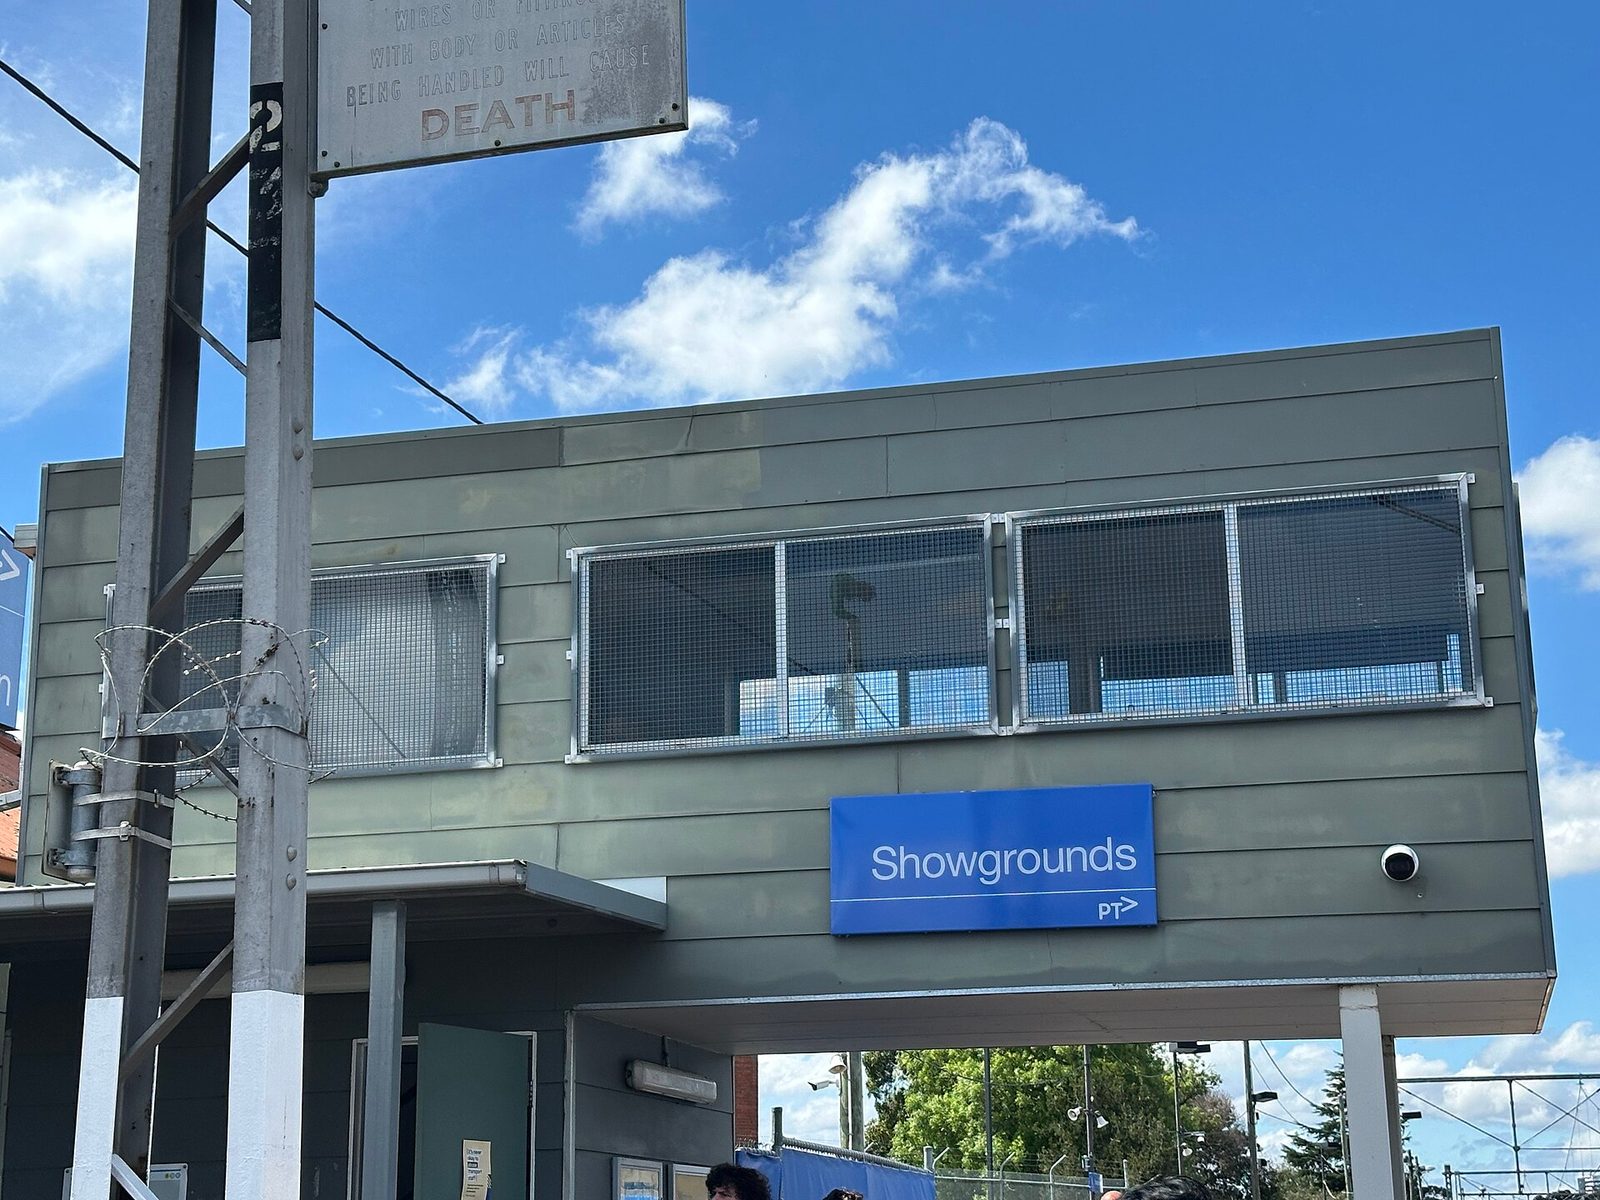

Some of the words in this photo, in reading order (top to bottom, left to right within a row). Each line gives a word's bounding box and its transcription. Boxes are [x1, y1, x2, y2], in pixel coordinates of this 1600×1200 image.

[370, 44, 413, 70] WITH
[430, 34, 475, 61] BODY
[495, 27, 519, 52] OR
[536, 14, 625, 46] ARTICLES
[394, 4, 452, 33] WIRES
[346, 80, 401, 108] BEING
[418, 65, 505, 97] HANDLED
[524, 56, 570, 82] WILL
[589, 44, 650, 73] CAUSE
[420, 89, 576, 142] DEATH
[871, 836, 1138, 885] Showgrounds
